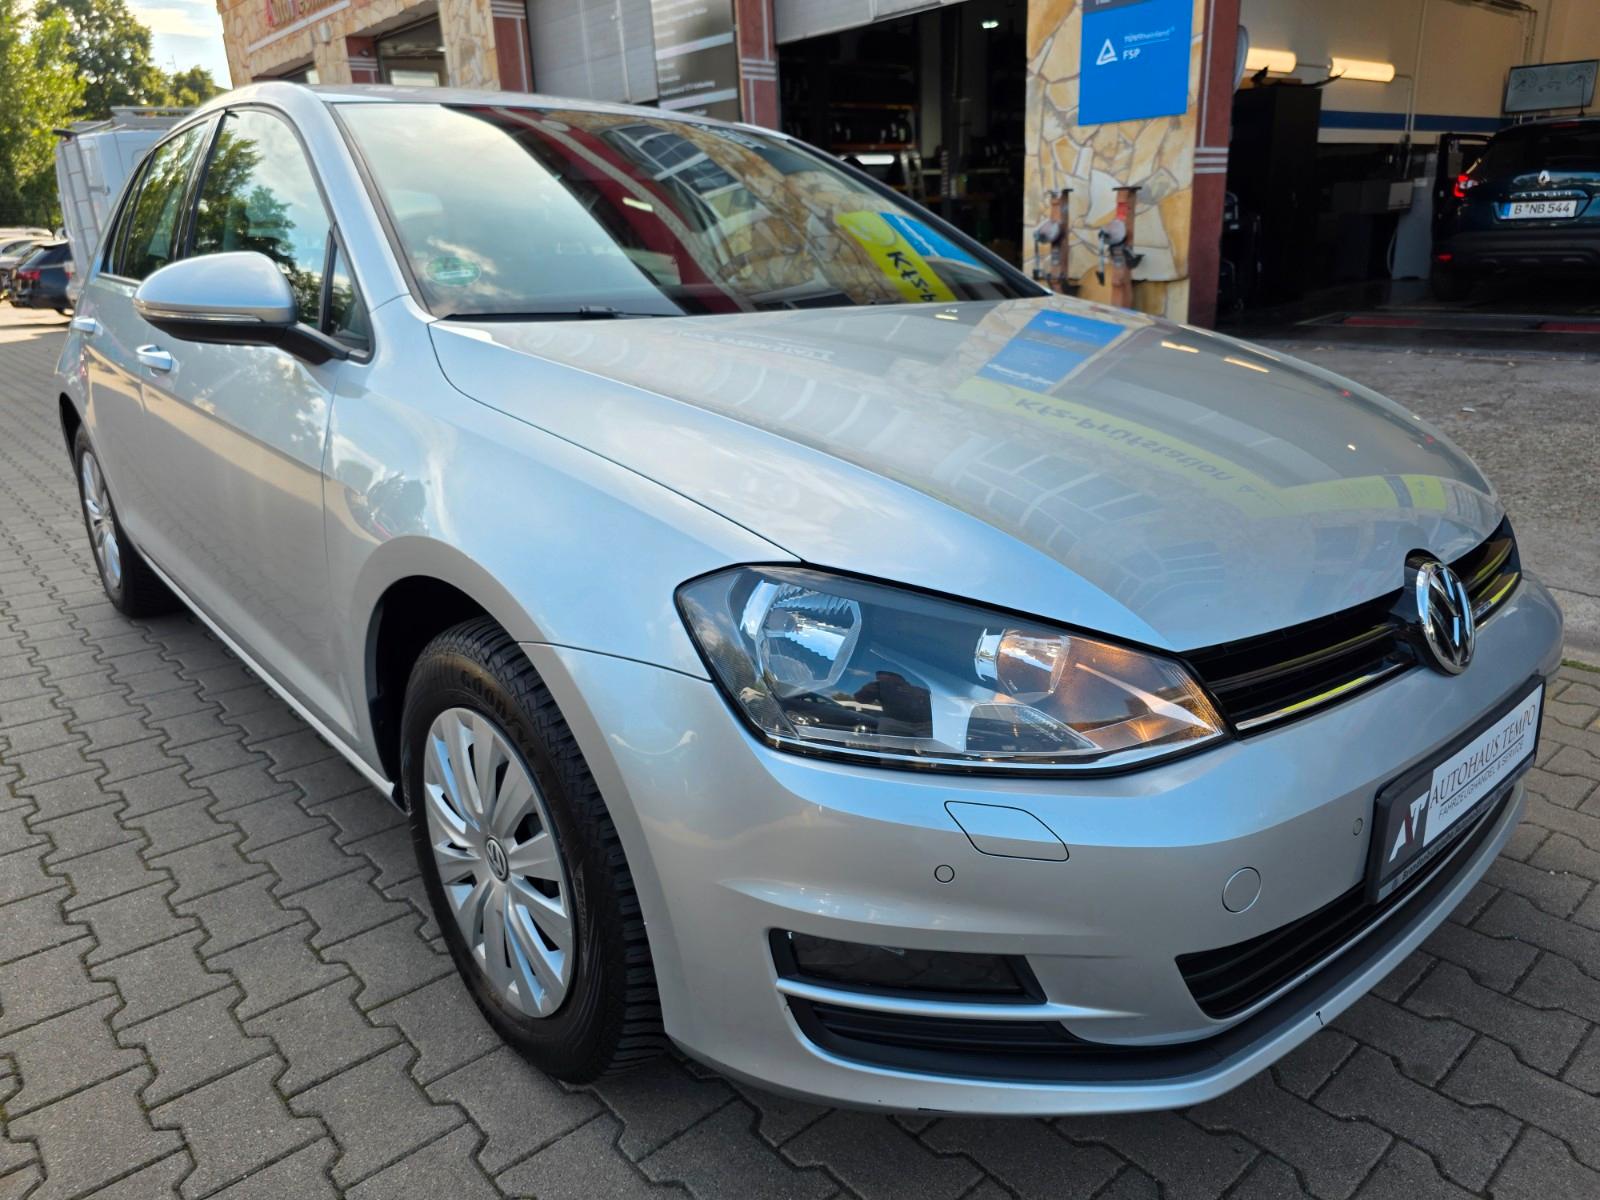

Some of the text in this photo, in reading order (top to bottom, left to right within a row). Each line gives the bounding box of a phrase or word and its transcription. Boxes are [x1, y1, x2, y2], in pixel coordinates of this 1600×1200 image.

[1122, 48, 1141, 60] FSP
[1514, 201, 1570, 215] B NB 544
[1430, 734, 1500, 809] AUTOHAUS
[1502, 704, 1536, 749] TEMPO
